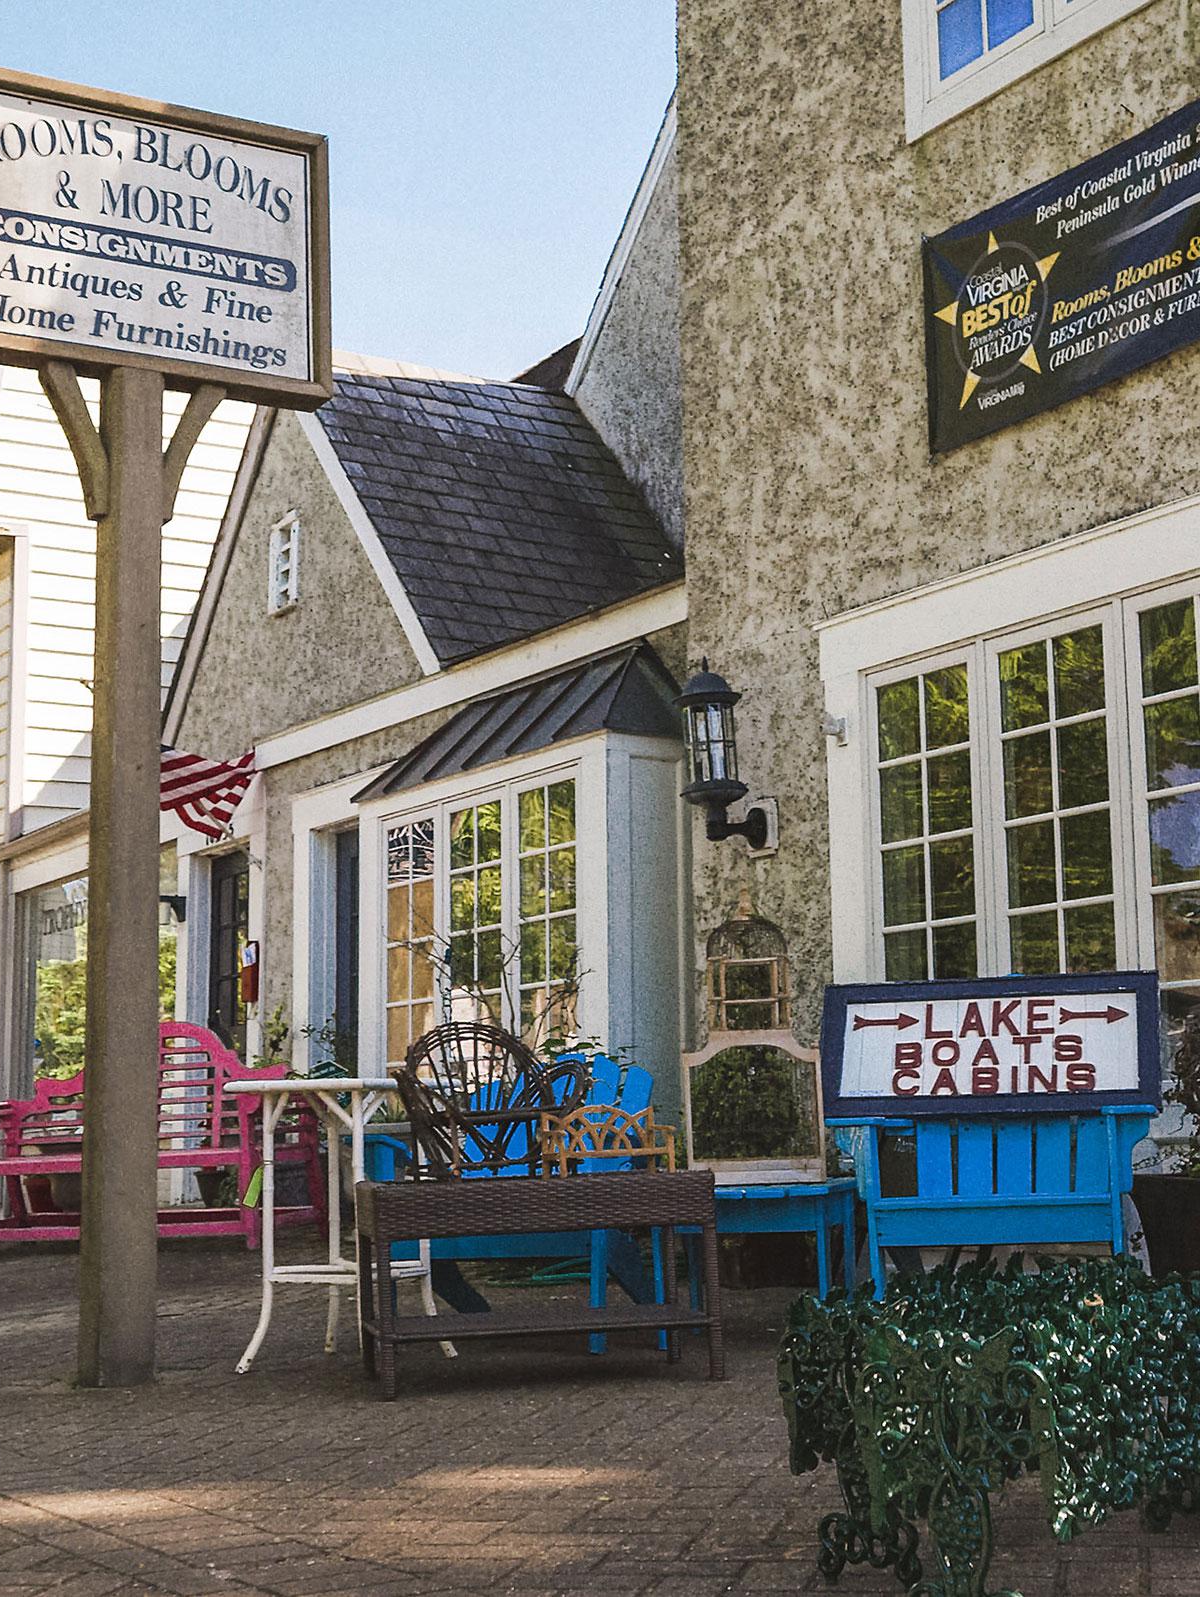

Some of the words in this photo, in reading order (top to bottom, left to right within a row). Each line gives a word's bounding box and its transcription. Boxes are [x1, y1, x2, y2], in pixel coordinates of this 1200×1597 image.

[133, 125, 293, 223] BLOOMS
[1035, 196, 1062, 225] Best
[1065, 185, 1081, 210] of
[1081, 158, 1132, 199] Coastal
[1134, 133, 1191, 172] Virginia
[55, 170, 79, 210] &
[100, 179, 213, 234] MORE
[1056, 195, 1120, 239] Peninsula
[1123, 173, 1156, 204] Gold
[966, 264, 1029, 306] VIRGINIA
[970, 262, 1003, 288] Coastal
[1050, 285, 1111, 324] Rooms,
[1112, 250, 1183, 294] Blooms
[159, 280, 188, 309] &
[202, 286, 273, 324] Fine
[89, 308, 287, 369] Furnishings
[969, 325, 1032, 370] AWARDS
[1048, 316, 1087, 349] BEST
[1049, 335, 1095, 372] (HOME
[1097, 313, 1151, 349] DECOR
[1153, 307, 1165, 325] &
[925, 999, 1056, 1039] LAKE
[894, 1034, 1083, 1069] BOATS
[892, 1062, 1096, 1096] CABINS
